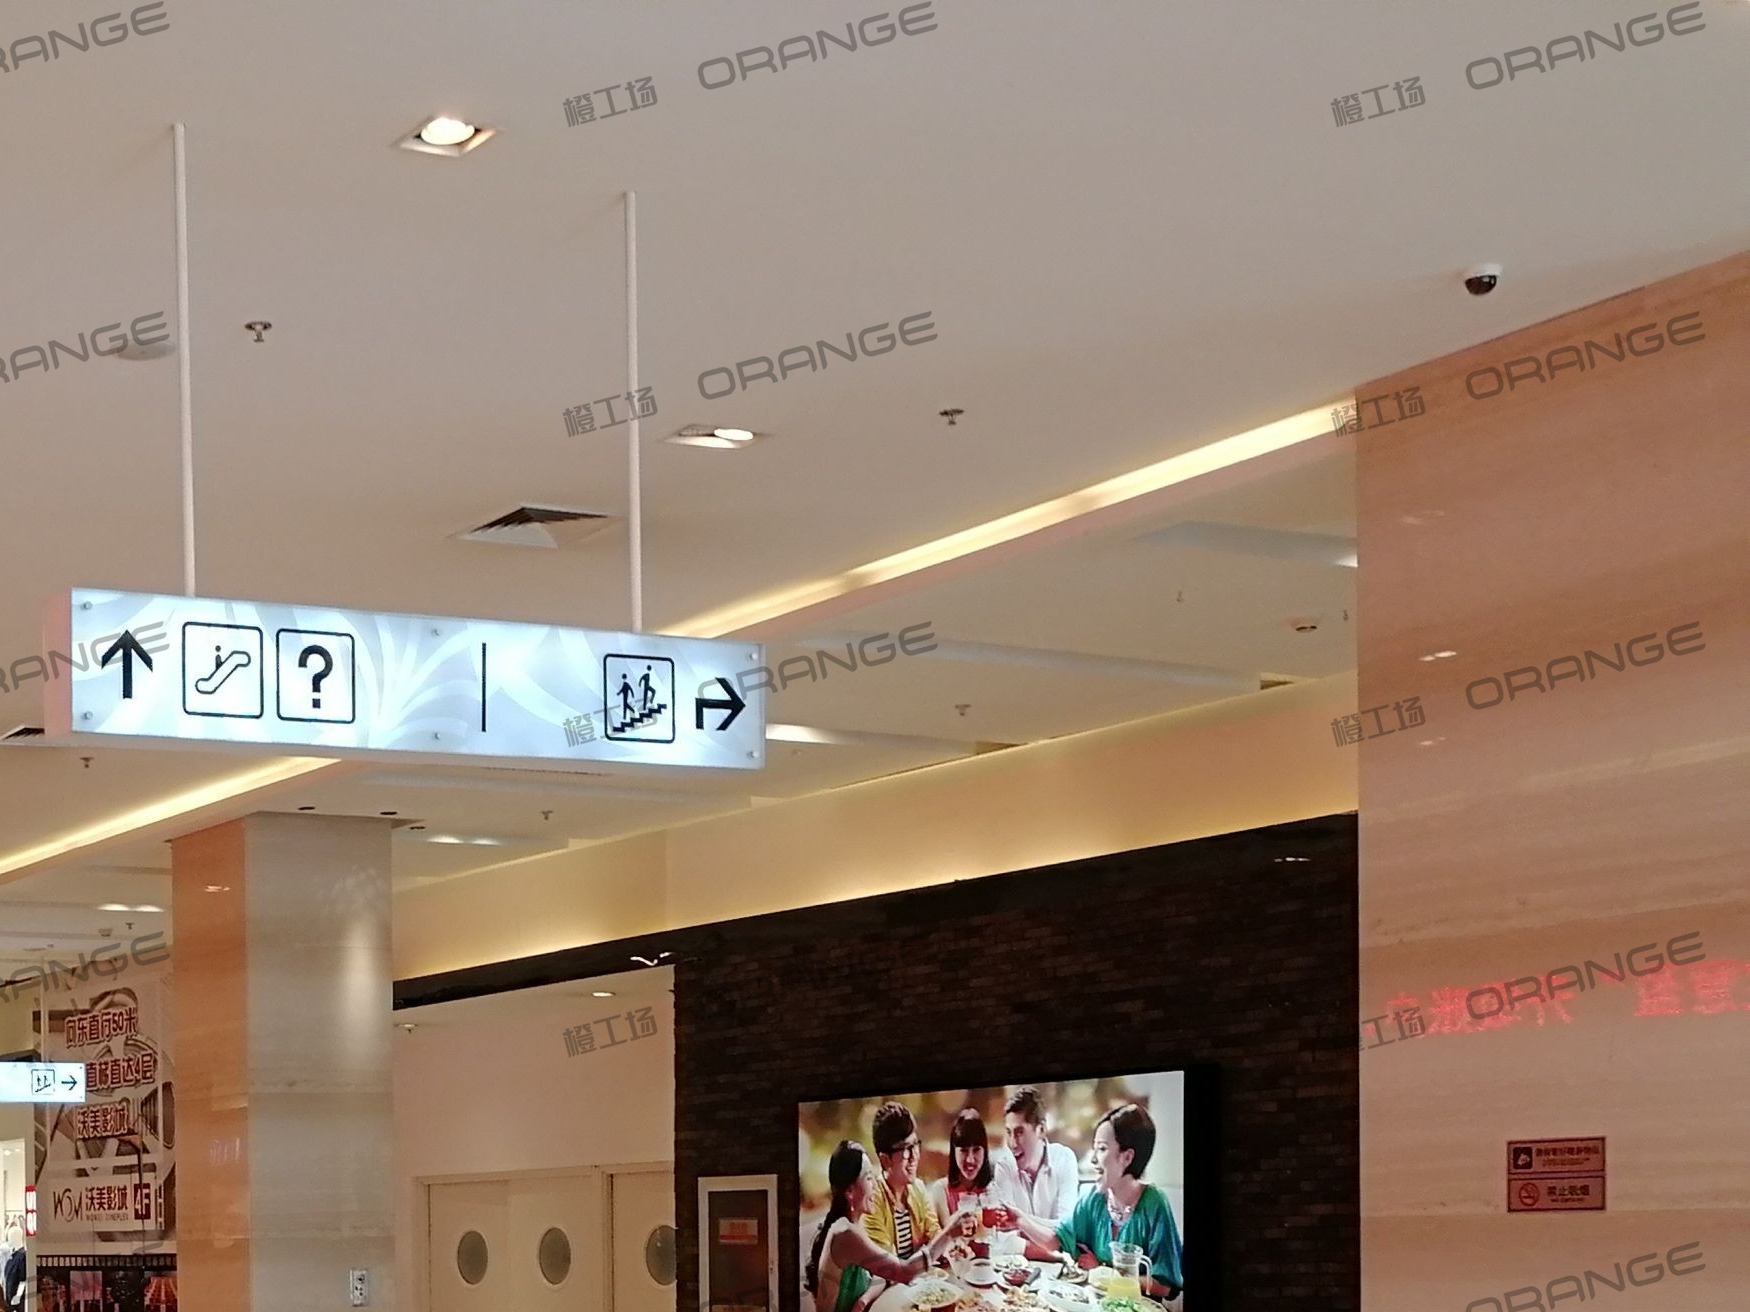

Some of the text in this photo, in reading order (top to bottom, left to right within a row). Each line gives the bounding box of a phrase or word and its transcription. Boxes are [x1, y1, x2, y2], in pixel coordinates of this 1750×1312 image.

[67, 1007, 137, 1045] 向东直行50米
[77, 1104, 129, 1138] 沃美影城
[85, 1185, 128, 1211] 沃美影城
[135, 1187, 151, 1216] 4F
